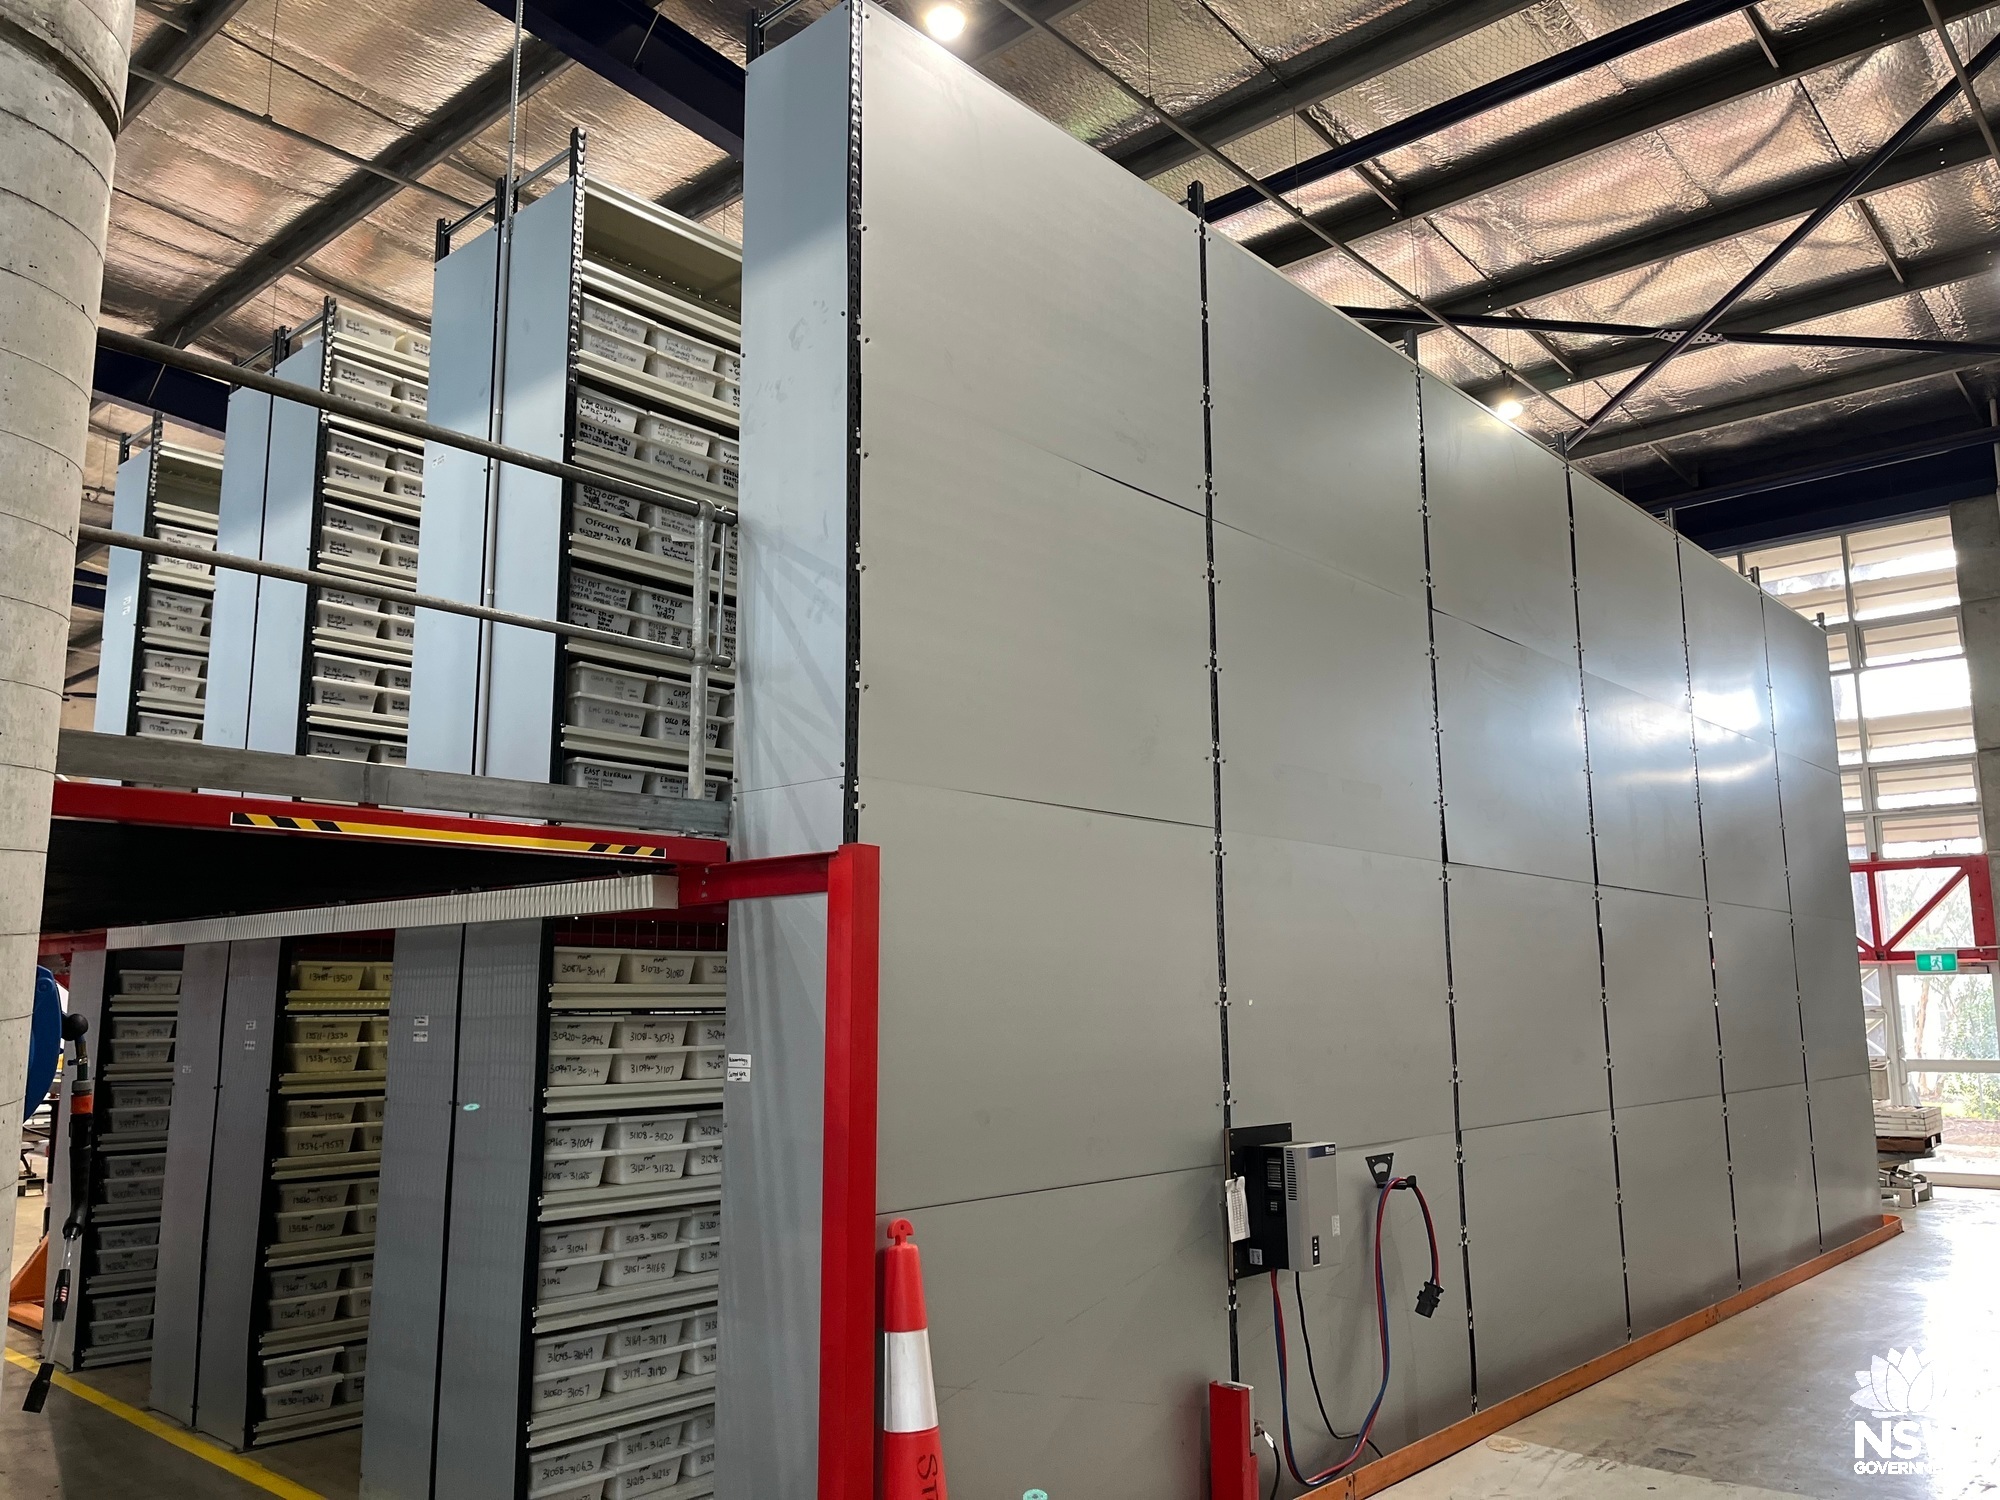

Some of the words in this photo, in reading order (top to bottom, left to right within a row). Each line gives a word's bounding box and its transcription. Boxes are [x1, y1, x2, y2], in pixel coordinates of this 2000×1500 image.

[585, 517, 620, 534] OFFCUTS
[583, 766, 600, 779] EAST
[603, 770, 632, 780] RIVERINA
